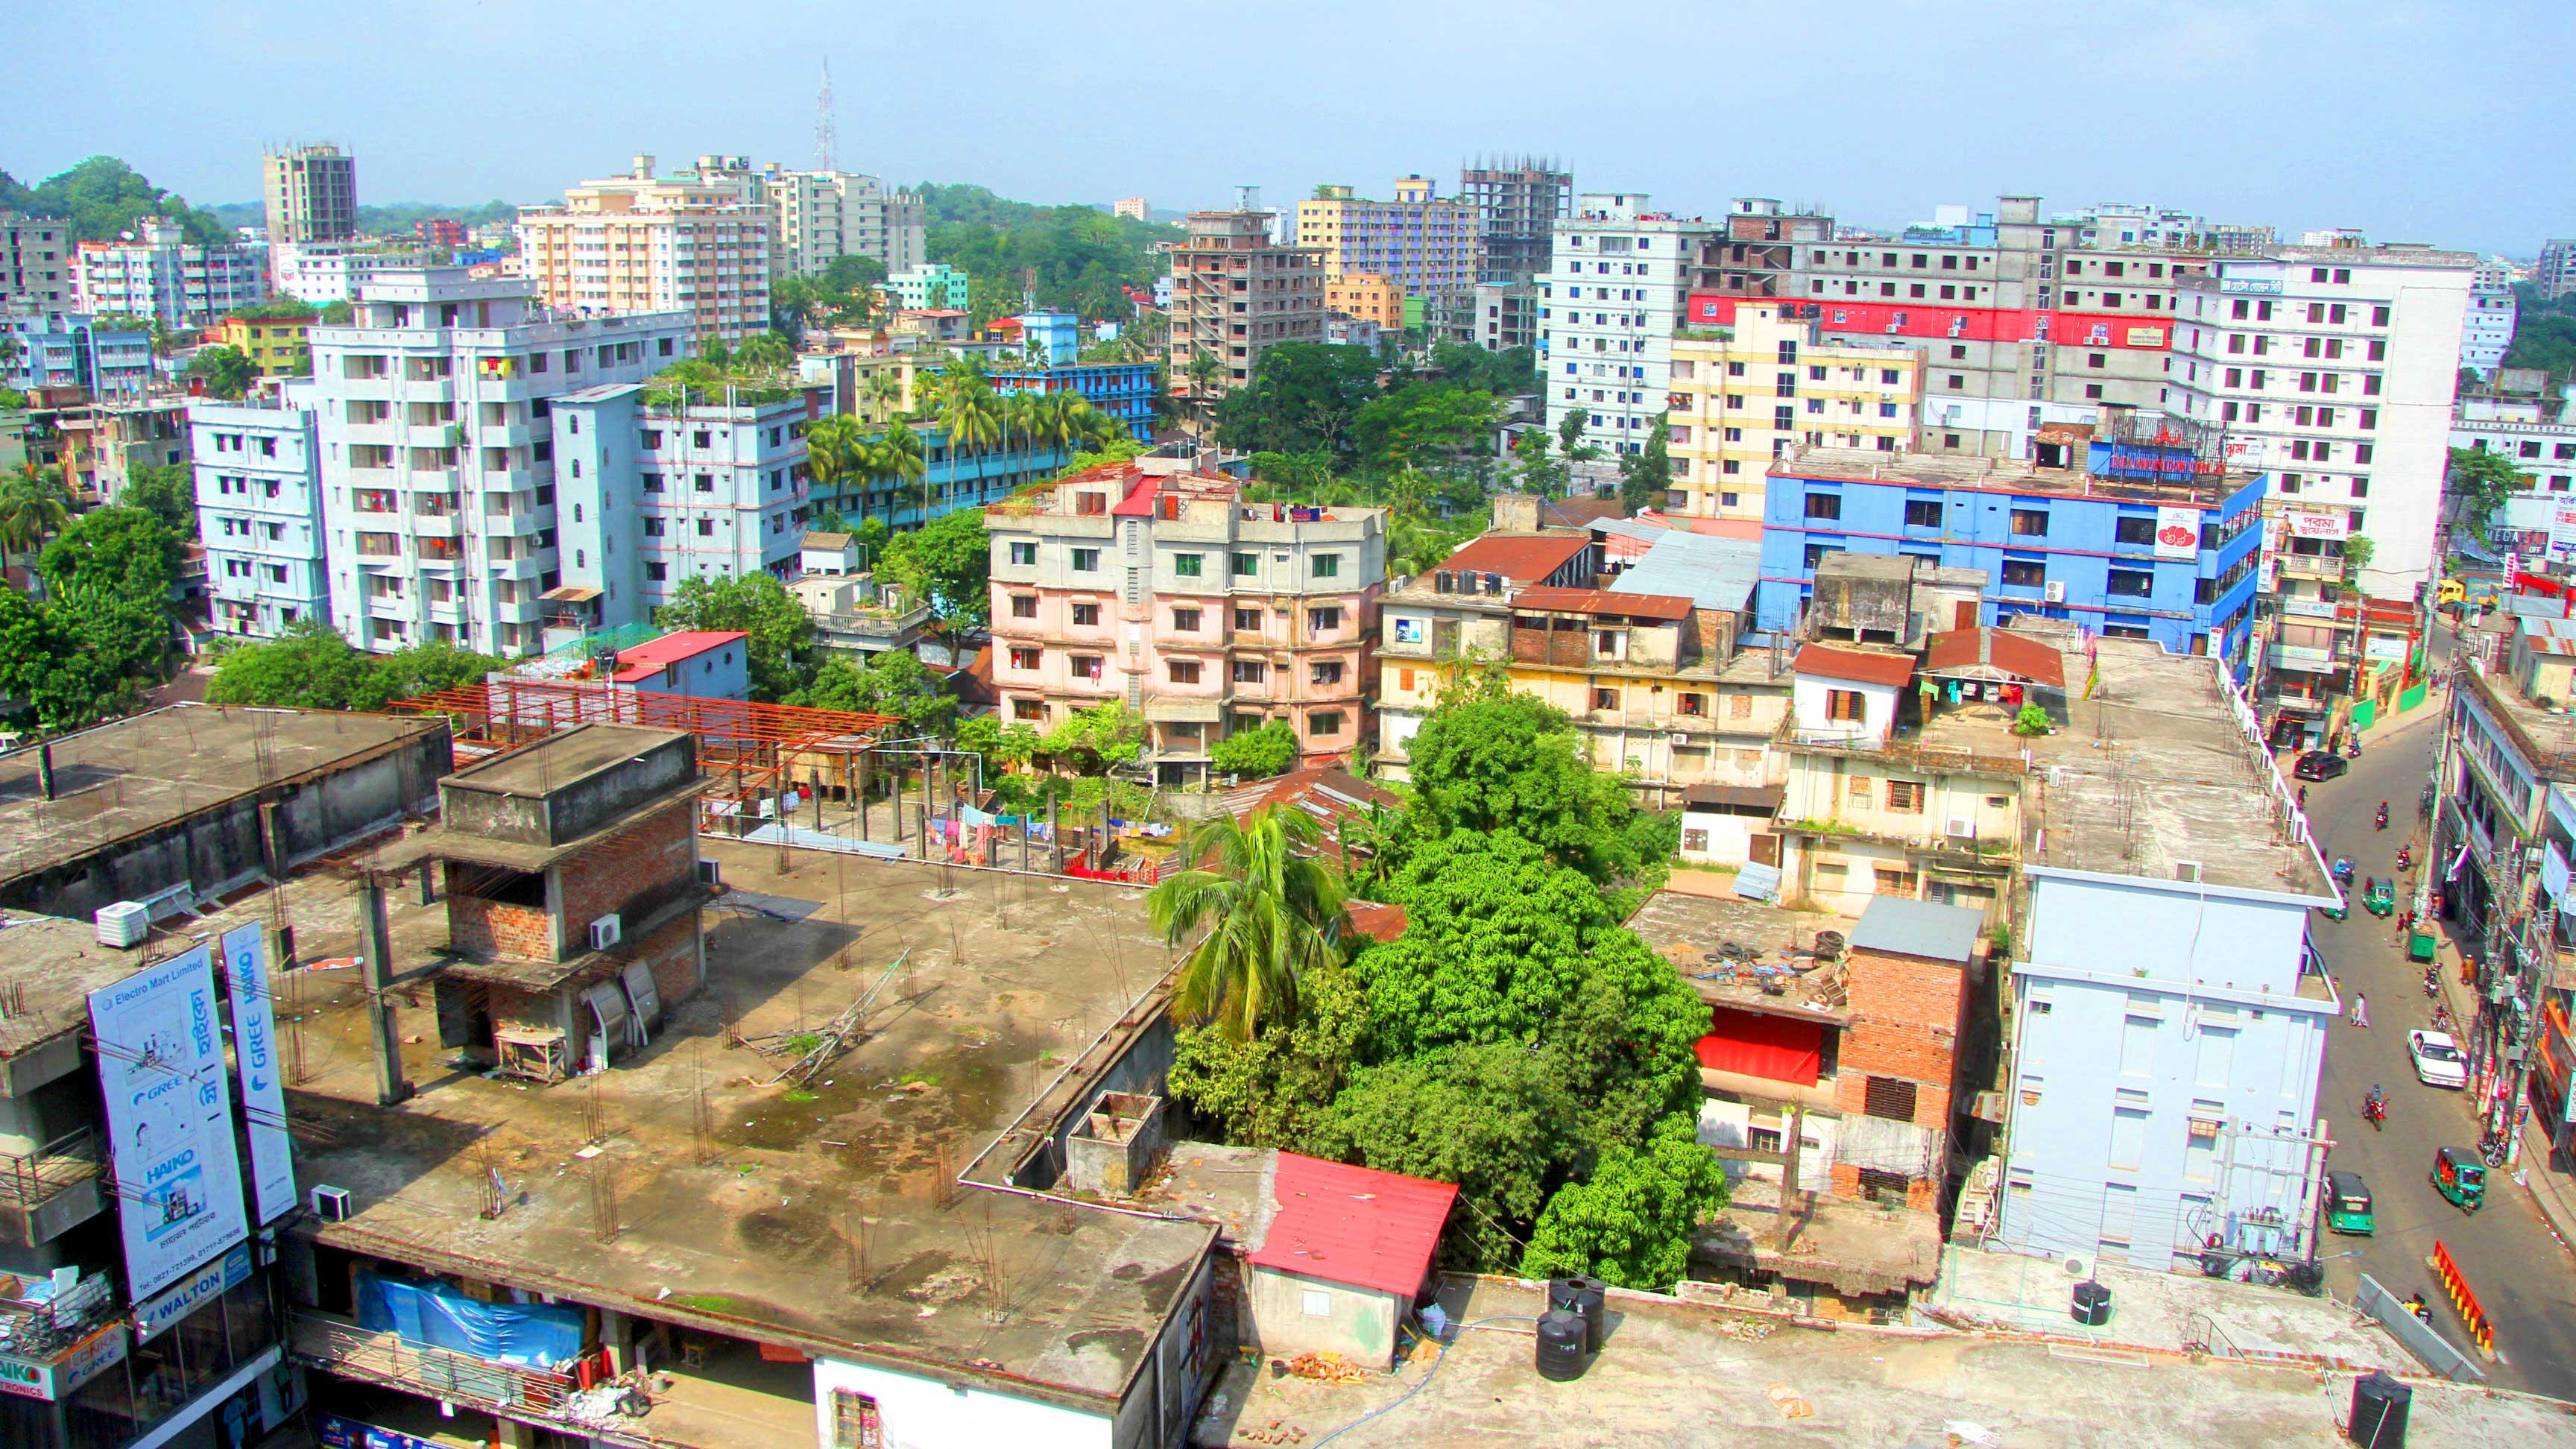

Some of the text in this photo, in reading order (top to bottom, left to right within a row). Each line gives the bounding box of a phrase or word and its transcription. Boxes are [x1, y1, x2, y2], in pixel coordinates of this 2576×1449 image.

[2303, 517, 2335, 528] পরমা
[2485, 529, 2519, 543] MEGA
[2528, 546, 2542, 554] OFF
[2504, 556, 2514, 585] Bata
[115, 958, 203, 1005] Electro Mart Limited
[239, 951, 258, 1005] HAIKO
[191, 988, 211, 1058] হাইকো
[247, 1011, 267, 1070] GREE
[148, 1076, 183, 1100] GREE
[145, 1149, 194, 1184] HAIKO
[139, 1281, 153, 1292] Tel:
[159, 1271, 221, 1319] WALTON
[82, 1348, 116, 1378] GREE
